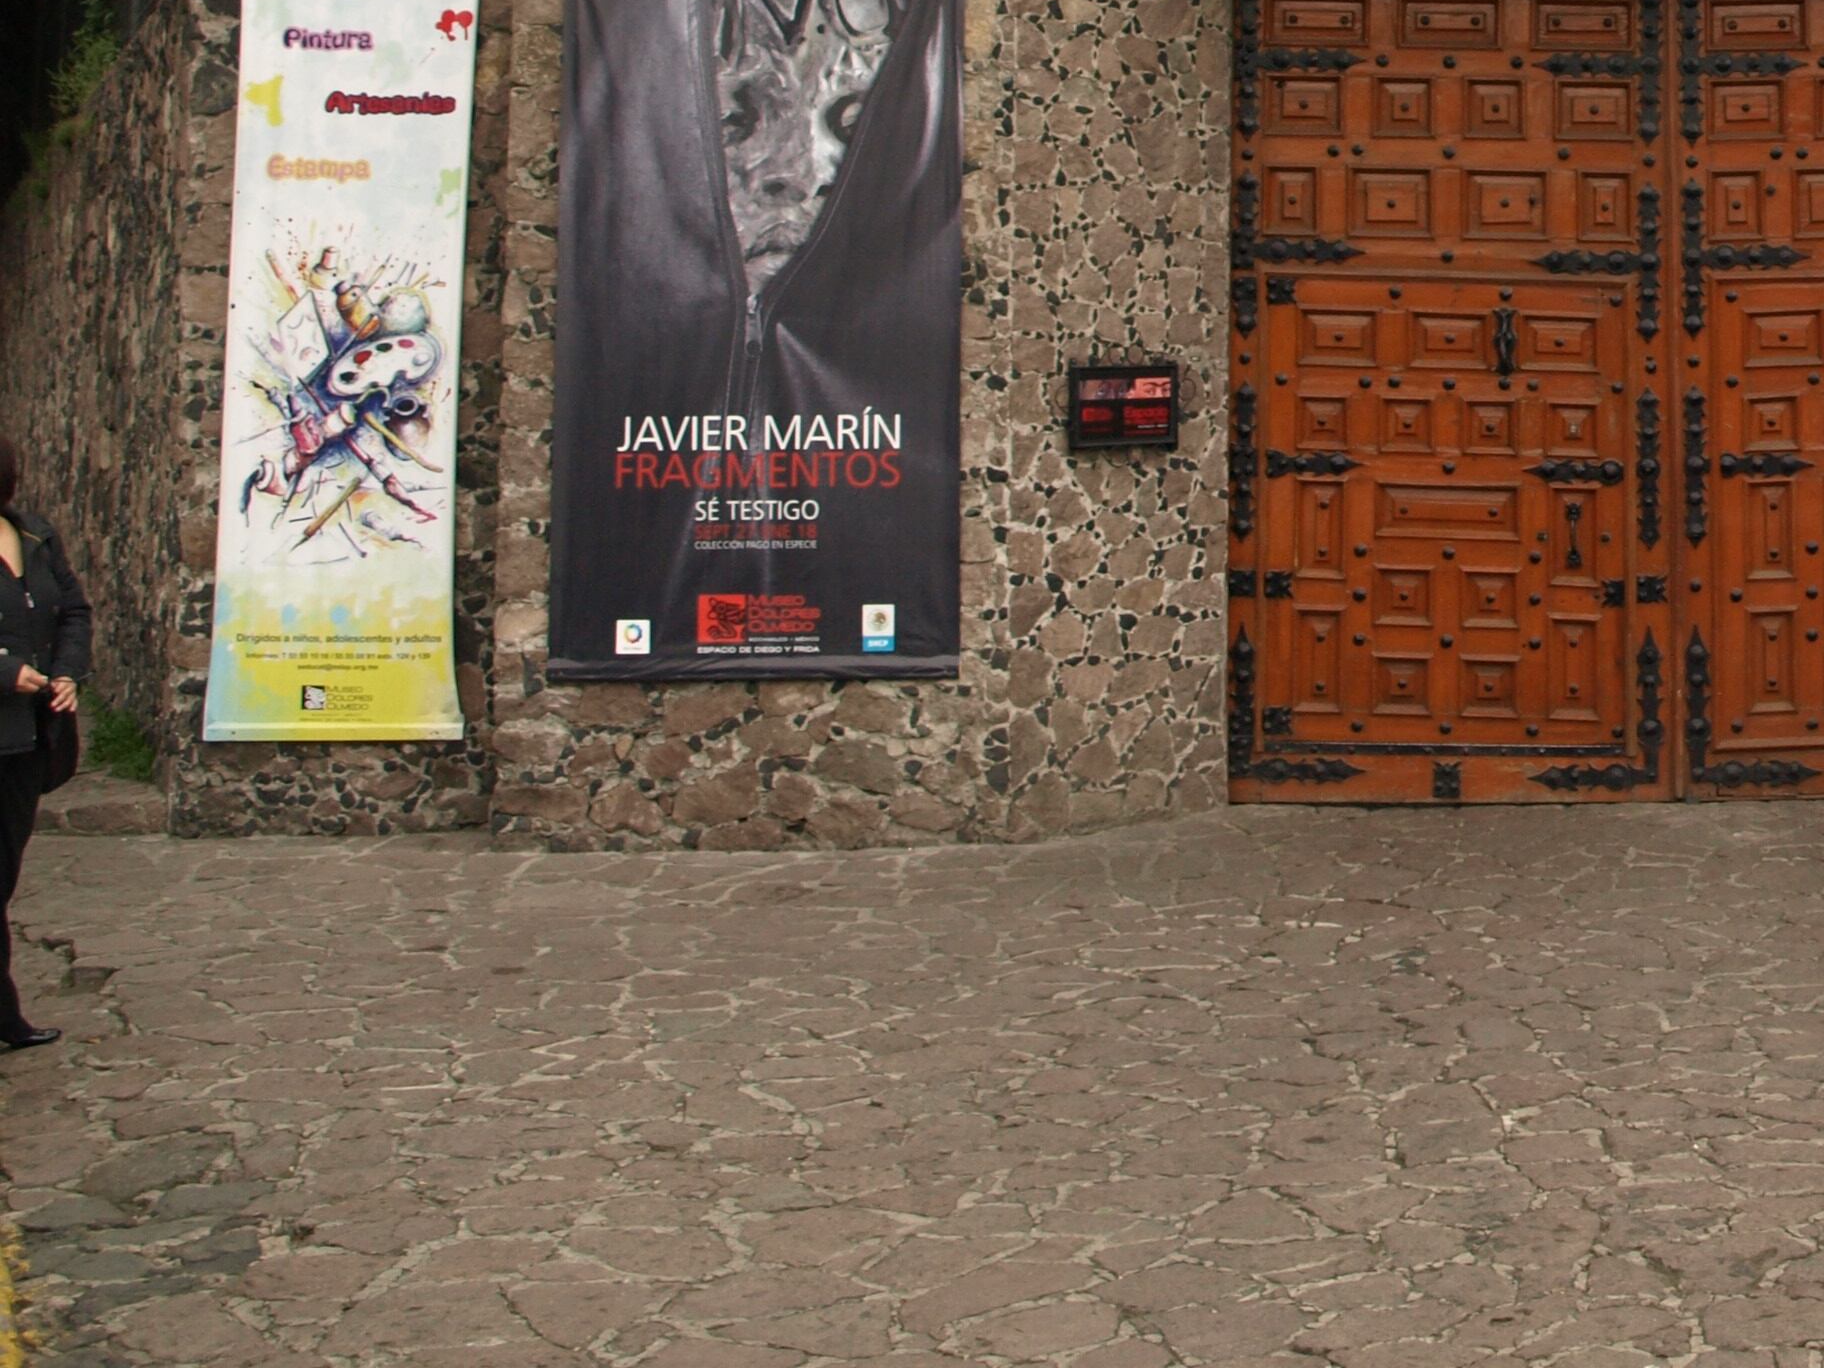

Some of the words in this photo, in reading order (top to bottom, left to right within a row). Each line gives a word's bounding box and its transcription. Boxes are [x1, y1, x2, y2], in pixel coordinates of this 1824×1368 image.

[283, 27, 373, 50] Pintura
[266, 154, 371, 183] Estampa
[616, 414, 749, 452] JAVIER
[763, 406, 901, 450] MARÍN
[614, 450, 901, 489] FRAGMENTOS
[694, 497, 720, 521] SÉ
[725, 499, 820, 521] TESTIGO
[771, 540, 784, 549] EN
[785, 539, 817, 549] ESPECIE
[748, 594, 805, 606] MUSEO
[748, 606, 821, 620] DOLORES
[748, 620, 815, 632] OLMEDO
[236, 632, 281, 644] Dirigidos
[325, 633, 392, 643] adolescentes
[404, 633, 441, 643] adultos
[697, 645, 737, 654] ESPACIO
[739, 646, 752, 654] DE
[754, 646, 783, 654] DIEGO
[793, 645, 820, 653] FRIDA
